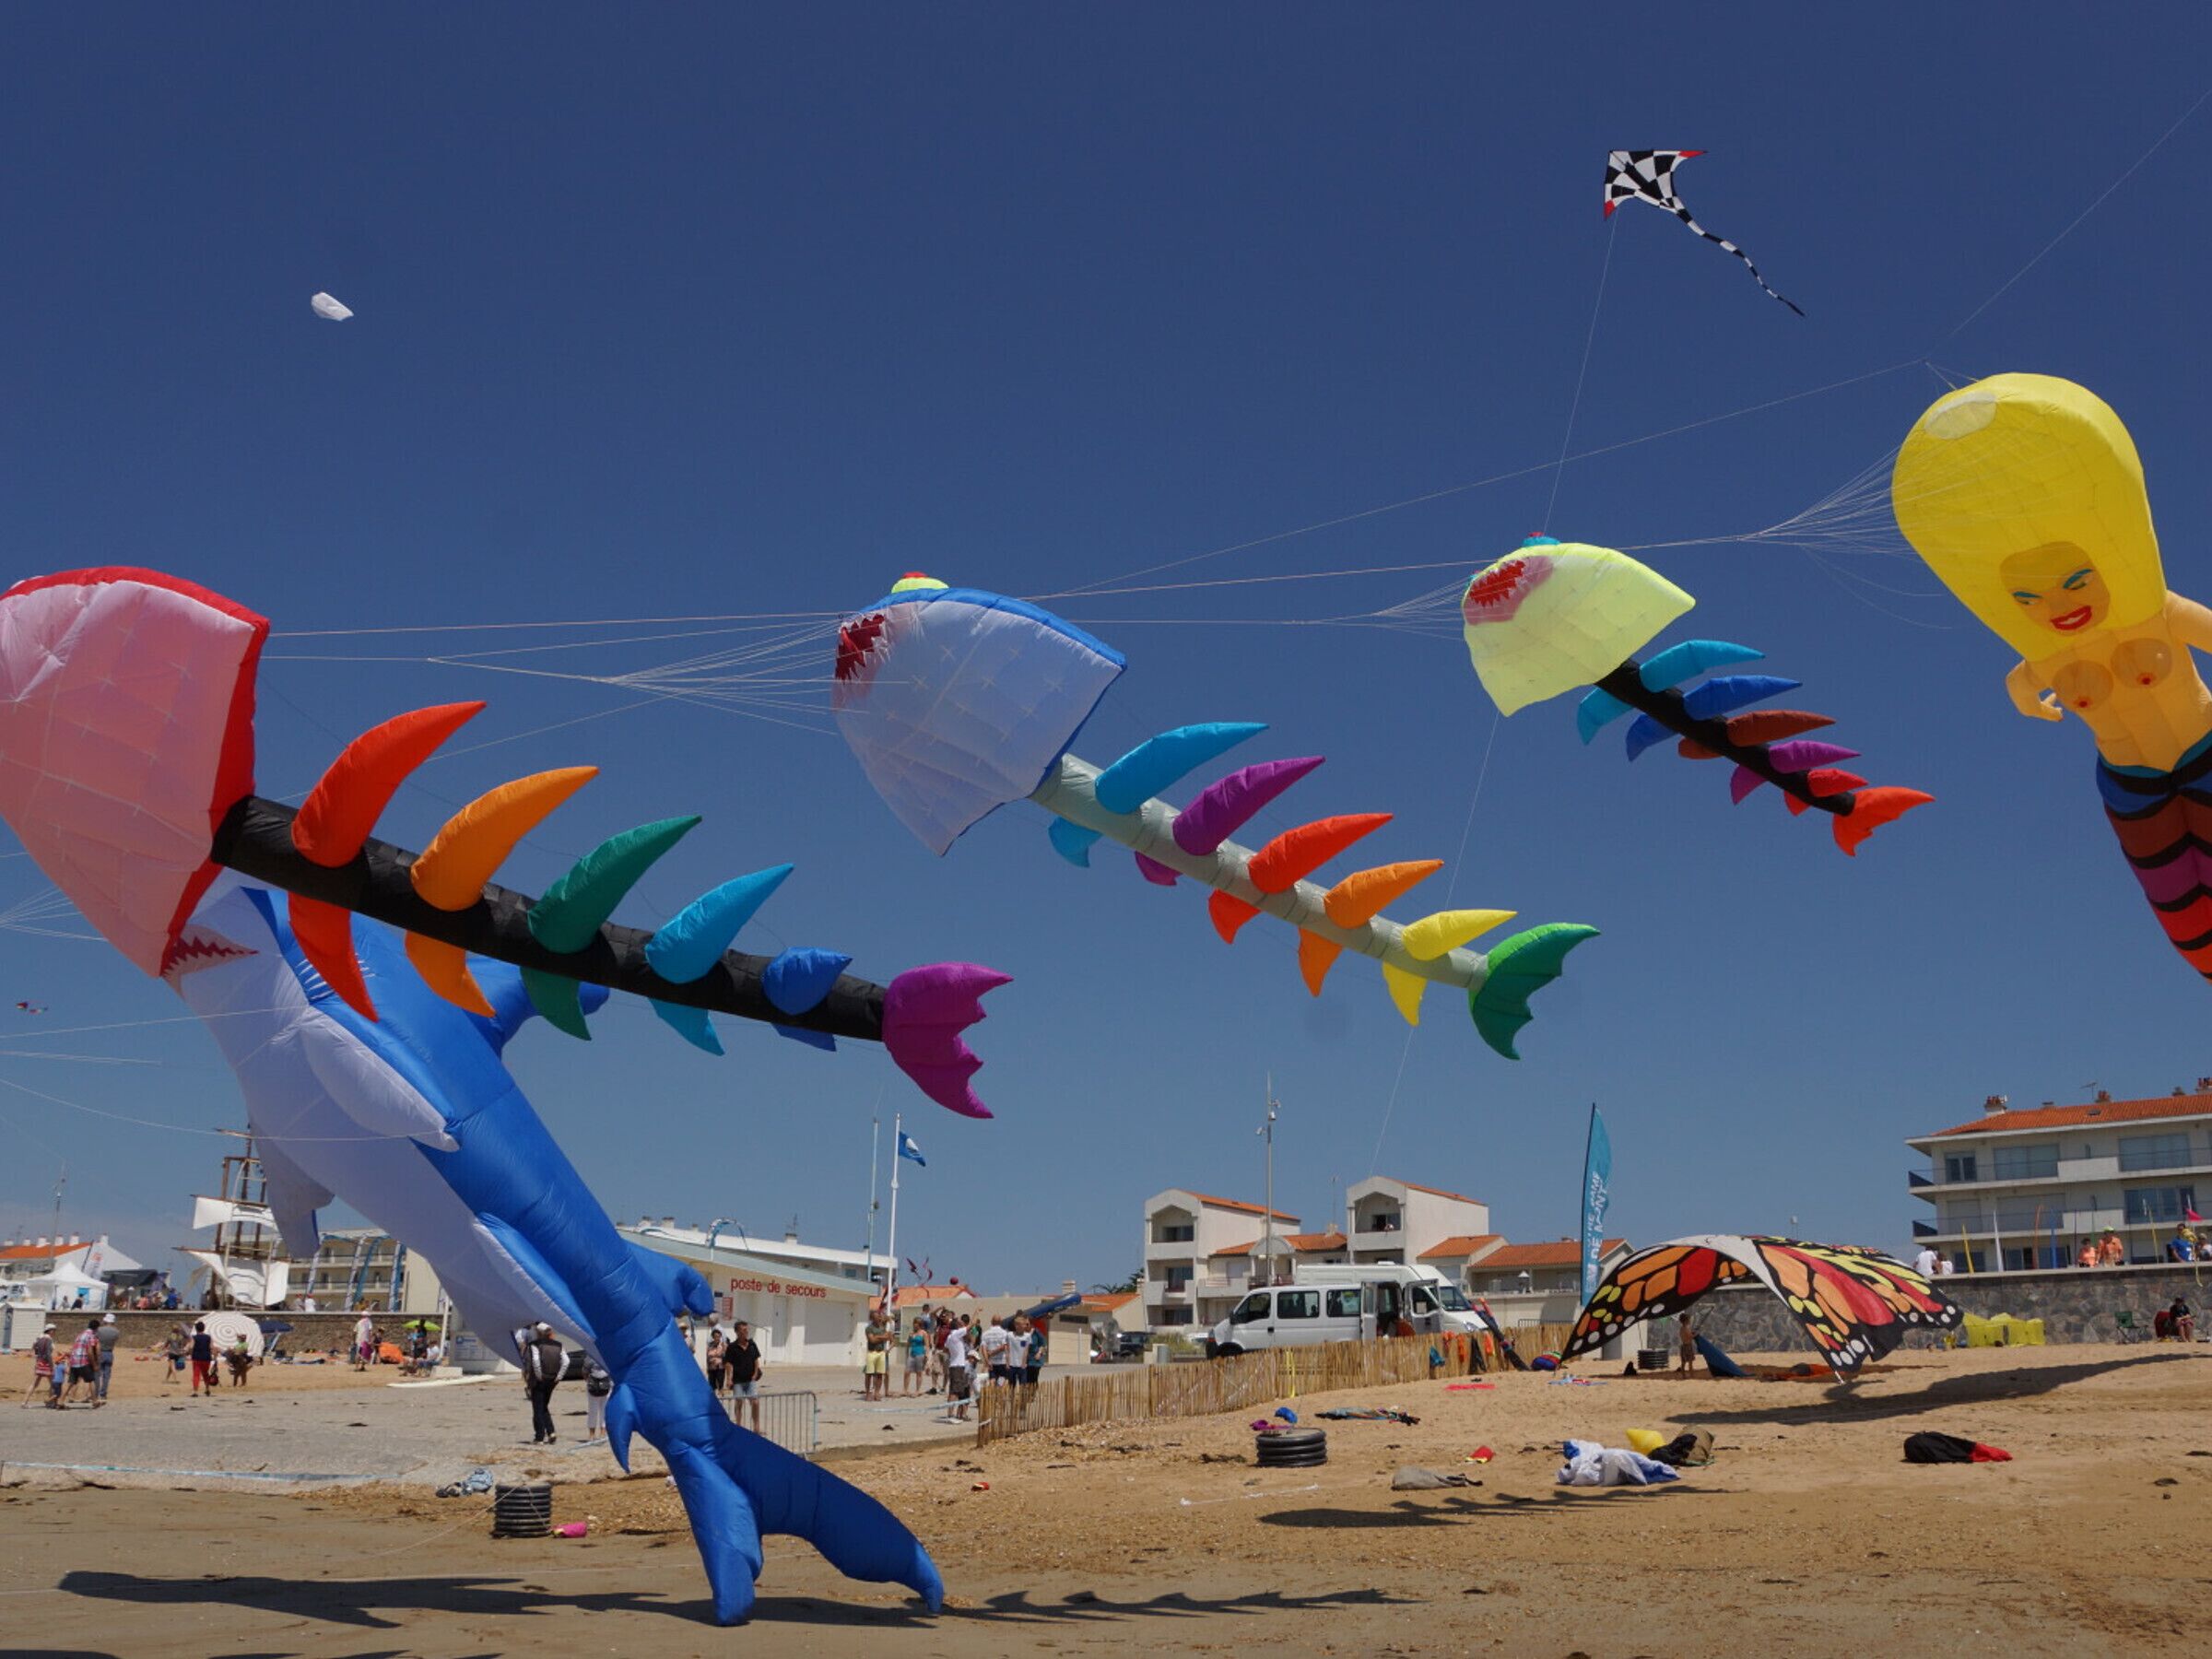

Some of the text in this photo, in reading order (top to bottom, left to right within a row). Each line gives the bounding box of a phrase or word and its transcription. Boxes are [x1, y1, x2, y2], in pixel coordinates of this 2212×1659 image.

[731, 1277, 827, 1298] poste de secours
